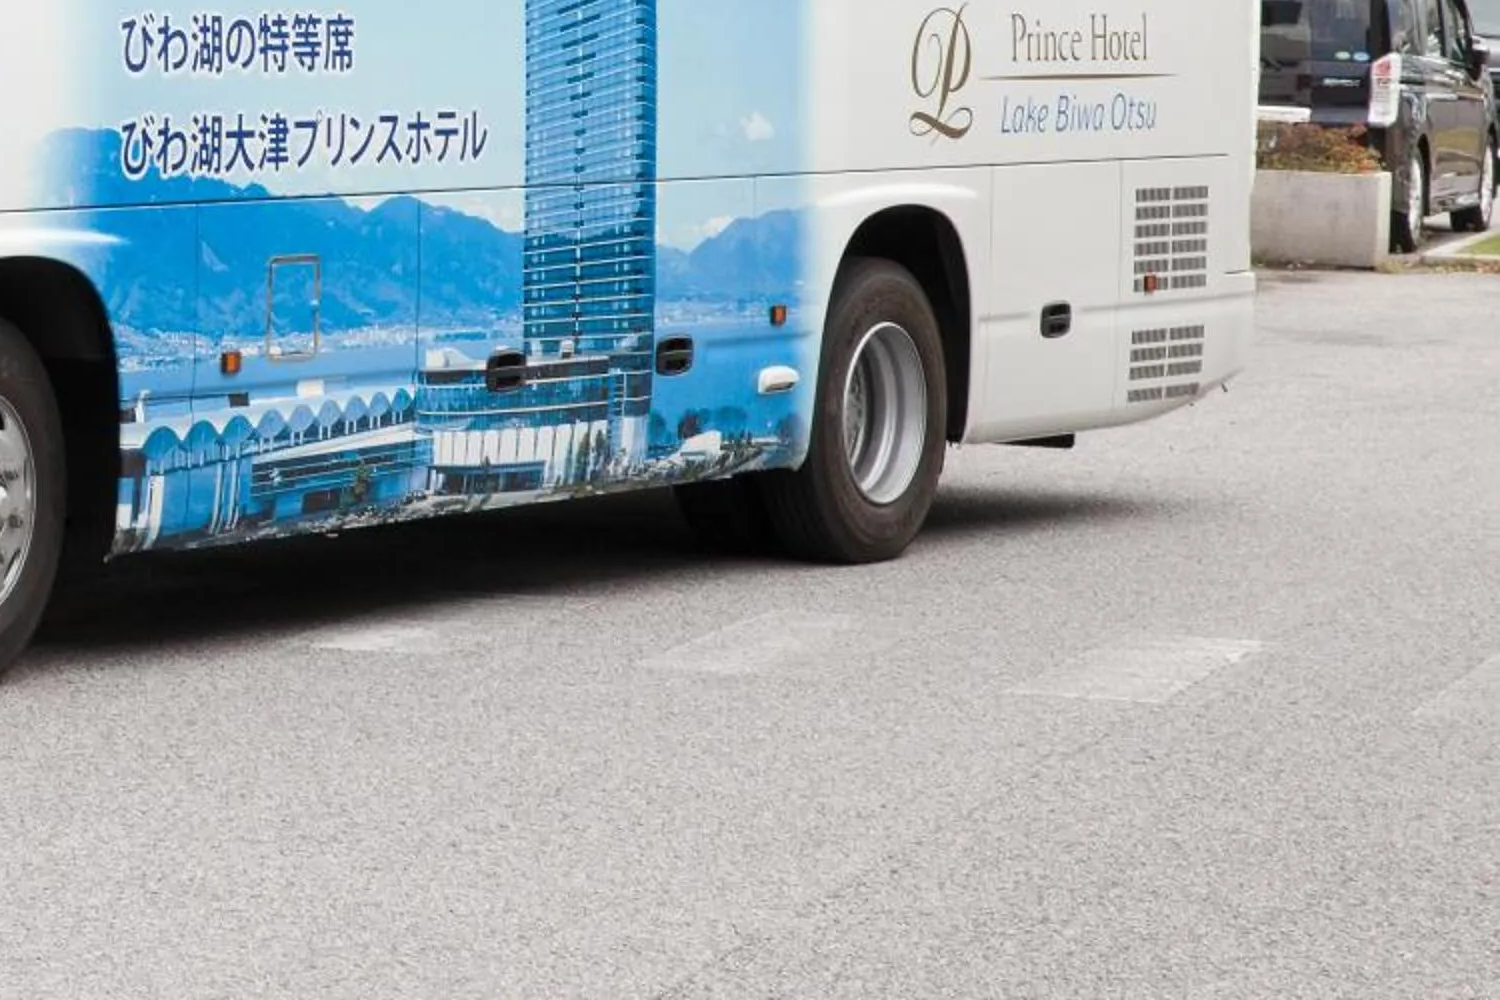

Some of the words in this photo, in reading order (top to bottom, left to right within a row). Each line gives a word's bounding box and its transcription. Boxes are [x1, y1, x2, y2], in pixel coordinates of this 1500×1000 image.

[121, 13, 355, 73] びわ湖の特等席
[1011, 13, 1083, 62] Prince
[1090, 12, 1149, 61] Hotel
[1000, 95, 1049, 134] Lake
[1055, 94, 1105, 132] Biwa
[1110, 92, 1158, 131] Otsu
[121, 110, 488, 175] びわ湖大津プリンスホテル
